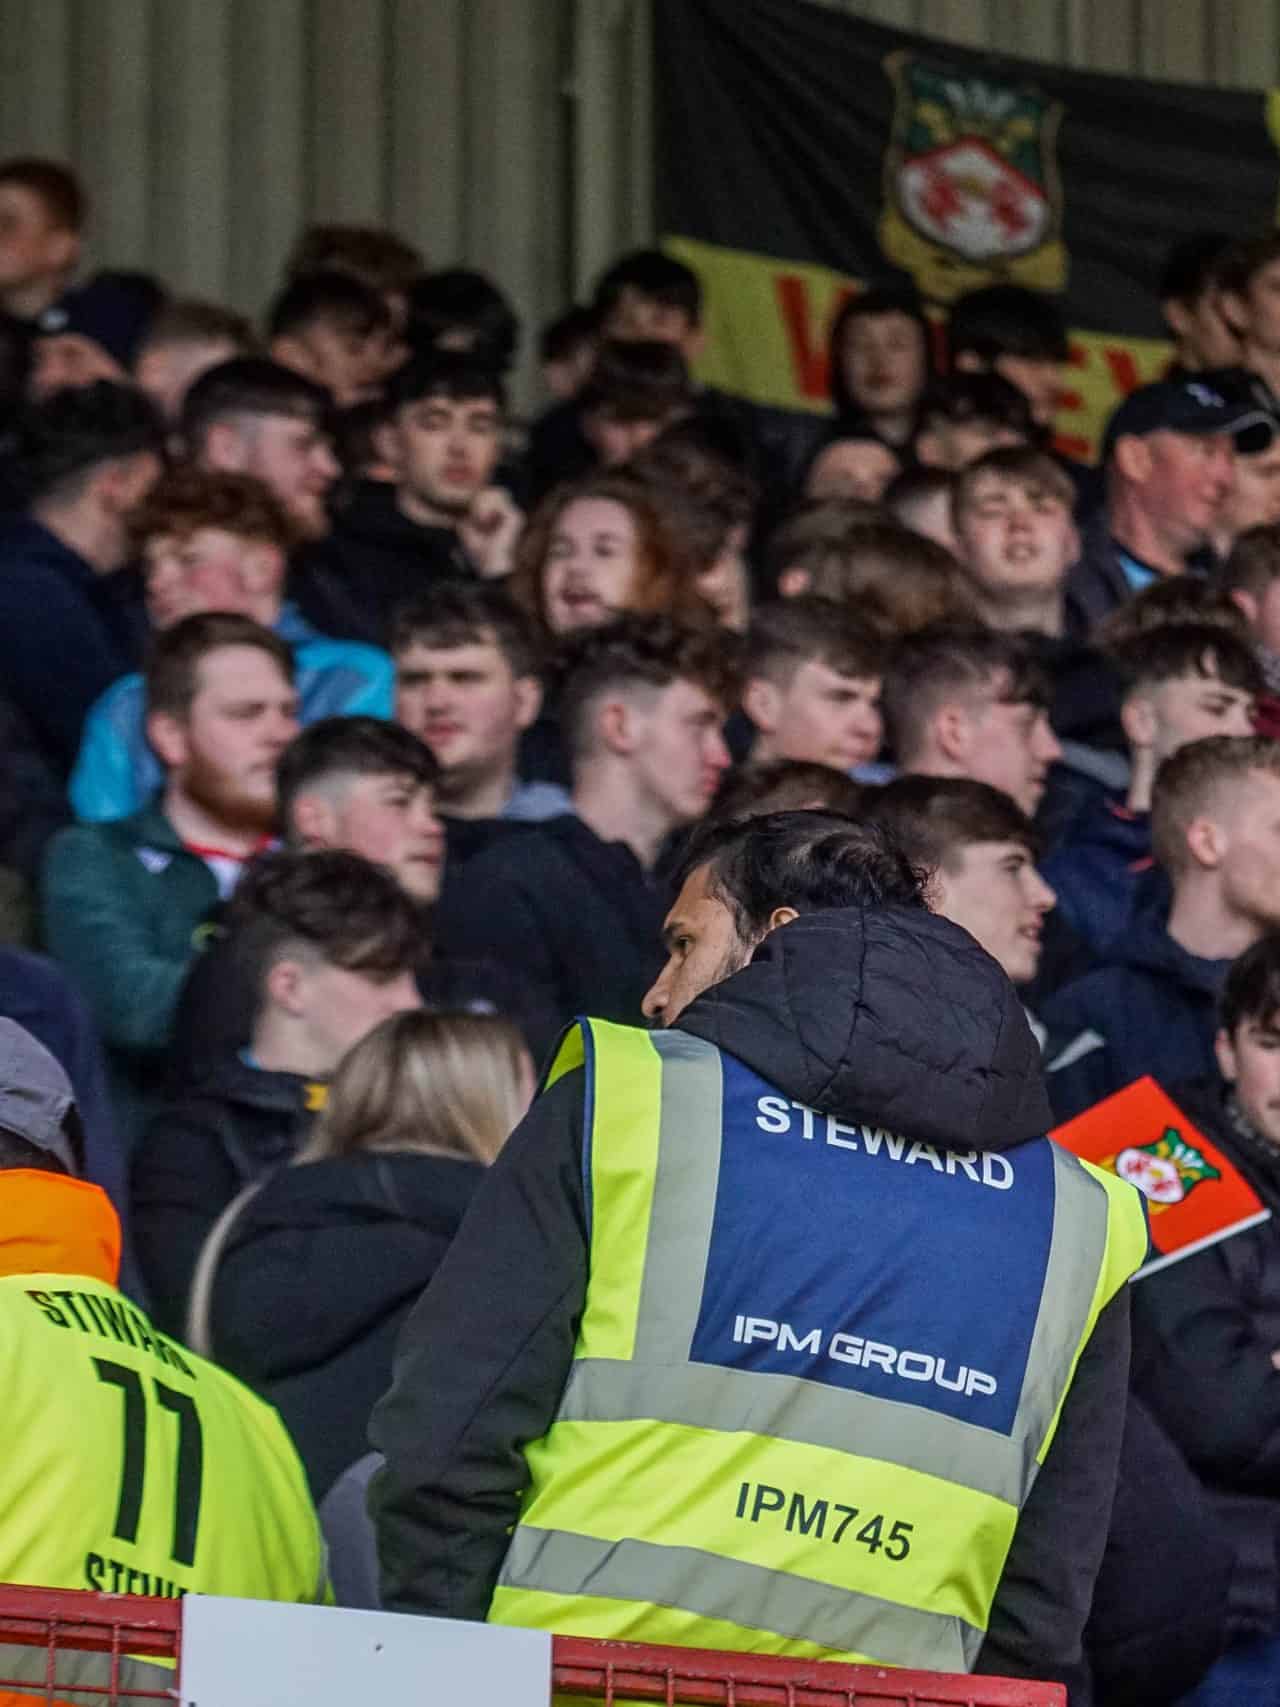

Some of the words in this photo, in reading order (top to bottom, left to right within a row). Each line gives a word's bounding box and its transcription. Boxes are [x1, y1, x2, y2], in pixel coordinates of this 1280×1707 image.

[755, 1095, 1015, 1190] STEWARD
[732, 1315, 822, 1354] IPM
[827, 1332, 998, 1397] GROUP
[735, 1481, 914, 1562] IPM745
